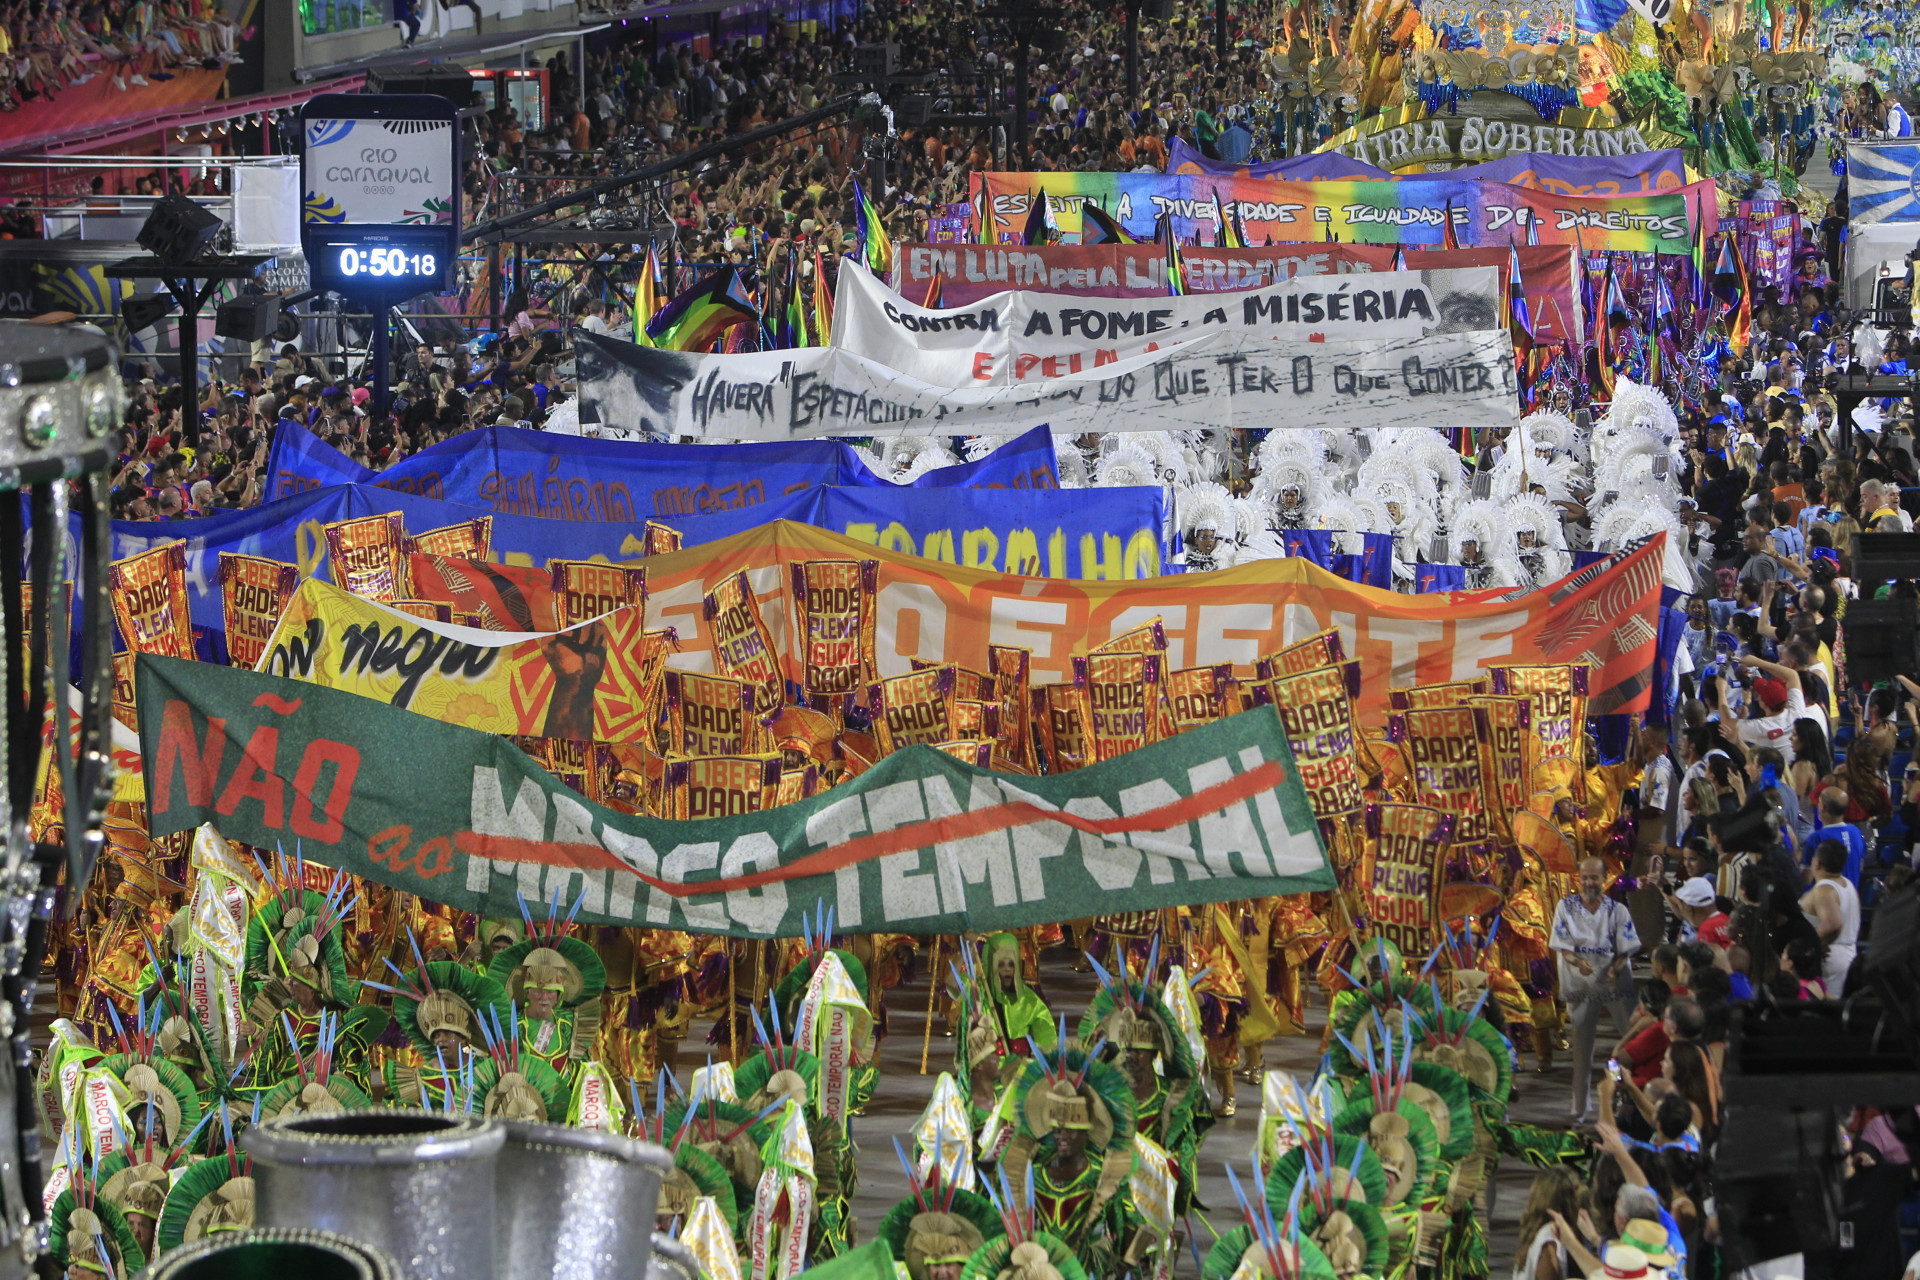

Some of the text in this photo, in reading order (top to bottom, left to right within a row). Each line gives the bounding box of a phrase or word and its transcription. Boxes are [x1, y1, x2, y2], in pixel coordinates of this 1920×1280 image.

[1460, 117, 1650, 157] SOBERANA
[361, 148, 397, 163] RIO
[1116, 192, 1132, 223] A
[1314, 207, 1331, 223] E
[266, 268, 308, 277] ESCOLAS
[340, 248, 436, 276] 0:50:18
[909, 248, 957, 283] EM
[965, 248, 1048, 287] LUTA
[1050, 266, 1119, 290] PELA
[265, 276, 308, 287] SAMBA
[884, 301, 1000, 333] CONTRA
[1023, 309, 1052, 337] A
[1203, 306, 1228, 325] A
[1243, 282, 1435, 325] MISÉRIA
[972, 352, 993, 381] E
[1153, 360, 1210, 405] QUE
[1217, 351, 1278, 395] TER
[1292, 355, 1312, 395] O
[1334, 365, 1390, 397] QUE
[340, 522, 387, 549] LIBER
[419, 526, 477, 555] LIBER
[343, 543, 389, 573] DADE
[237, 558, 279, 590] LIBER
[567, 567, 625, 597] LIBER
[809, 563, 859, 588] LIBER
[235, 581, 279, 616] DADE
[808, 588, 859, 614] DADE
[808, 616, 859, 640] PLENA
[808, 641, 859, 666] IGUAL
[1110, 602, 1530, 690] GENTE
[807, 665, 859, 692] DADE
[1091, 658, 1143, 683] LIBER
[1510, 668, 1571, 694] LIBER
[683, 675, 740, 709] LIBER
[885, 675, 940, 709] LIBER
[1092, 682, 1143, 710] DADE
[1277, 671, 1345, 710] LIBER
[1534, 691, 1571, 717] ADE
[683, 701, 741, 735] DADE
[888, 699, 948, 733] DADE
[1174, 692, 1220, 722] ADE
[1281, 697, 1349, 735] DADE
[1094, 712, 1145, 736] PLENA
[1409, 710, 1472, 738] LIBER
[1538, 718, 1572, 742] ENA
[684, 728, 741, 756] PLENA
[1289, 728, 1352, 762] PLENA
[1413, 735, 1477, 762] DADE
[690, 760, 761, 792] LIBER
[1417, 764, 1480, 790] PLENA
[151, 691, 361, 846] NÃO
[465, 765, 788, 935] MARCO
[805, 744, 1325, 929] TEMPORAL
[690, 786, 761, 816] DADE
[1380, 806, 1438, 839] LIBER
[1380, 833, 1436, 867] DADE
[1373, 866, 1432, 897] PLENA
[1371, 894, 1430, 926] IGUAL
[801, 1001, 814, 1052] TEMPORA
[828, 1038, 843, 1095] TEMPORAL
[91, 1081, 113, 1125] MARCO
[585, 1080, 600, 1119] MARCO
[788, 1210, 805, 1277] TEMPORAL
